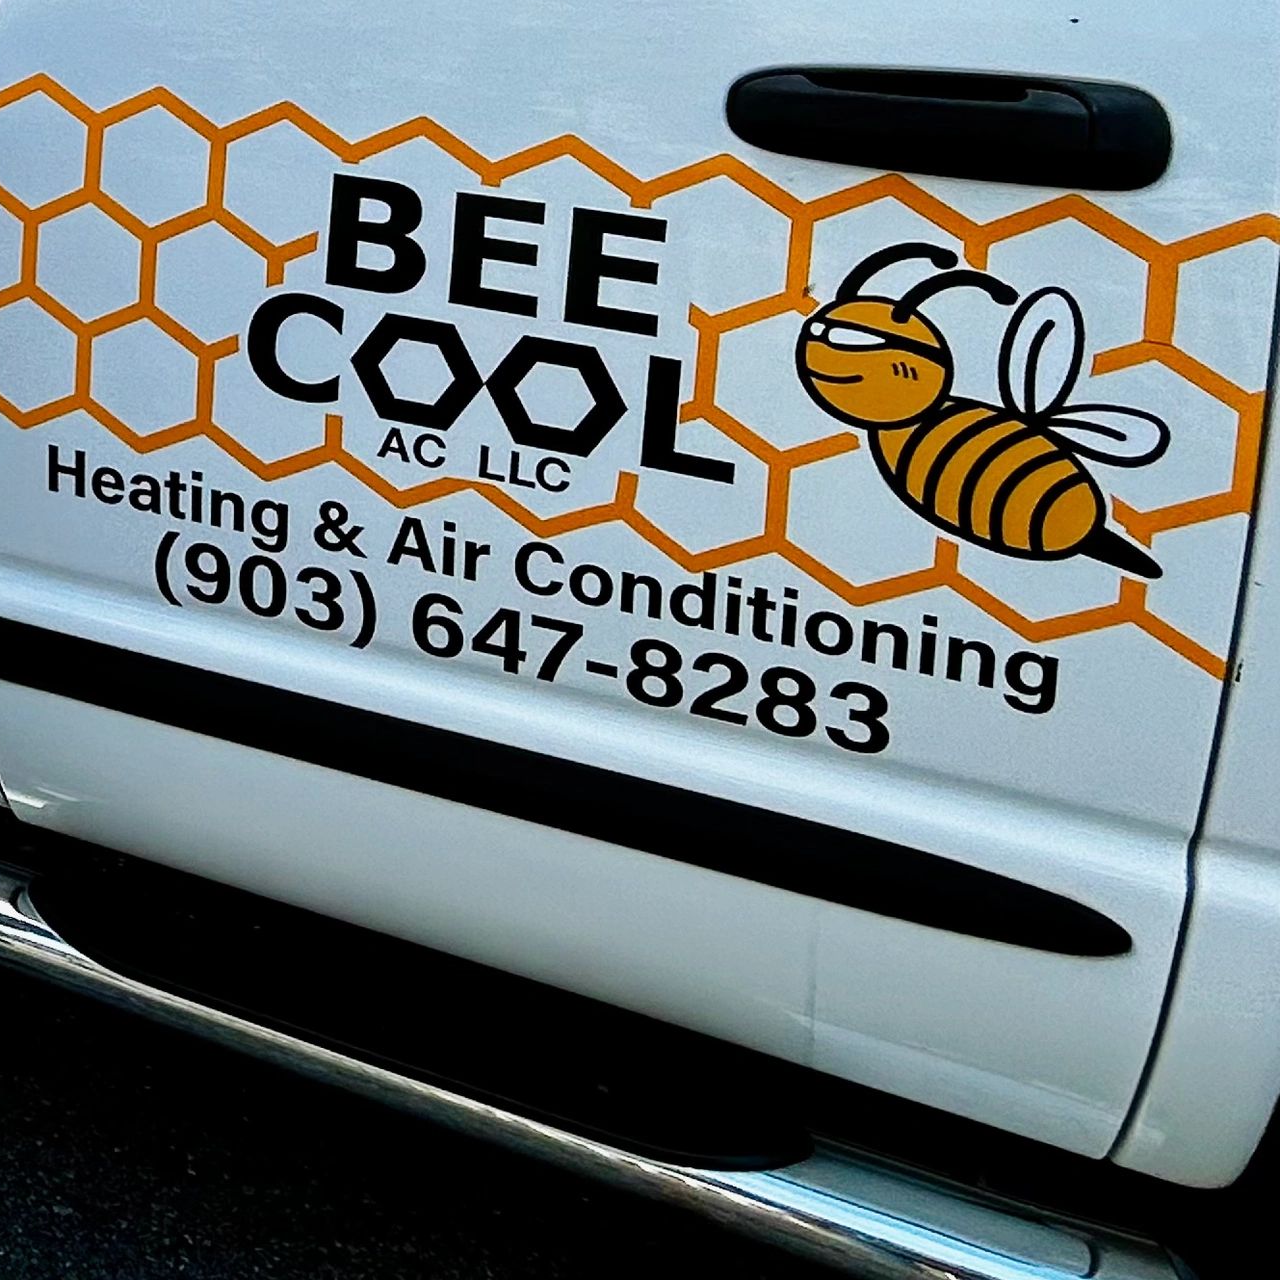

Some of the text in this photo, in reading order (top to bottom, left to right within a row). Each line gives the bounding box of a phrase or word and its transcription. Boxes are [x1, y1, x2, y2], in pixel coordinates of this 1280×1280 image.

[324, 172, 668, 338] BEE
[246, 291, 736, 486] COOL
[376, 426, 572, 494] AC LLC
[47, 443, 1060, 716] Heating & Air Conditioning
[153, 529, 891, 755] (903) 647-8283
